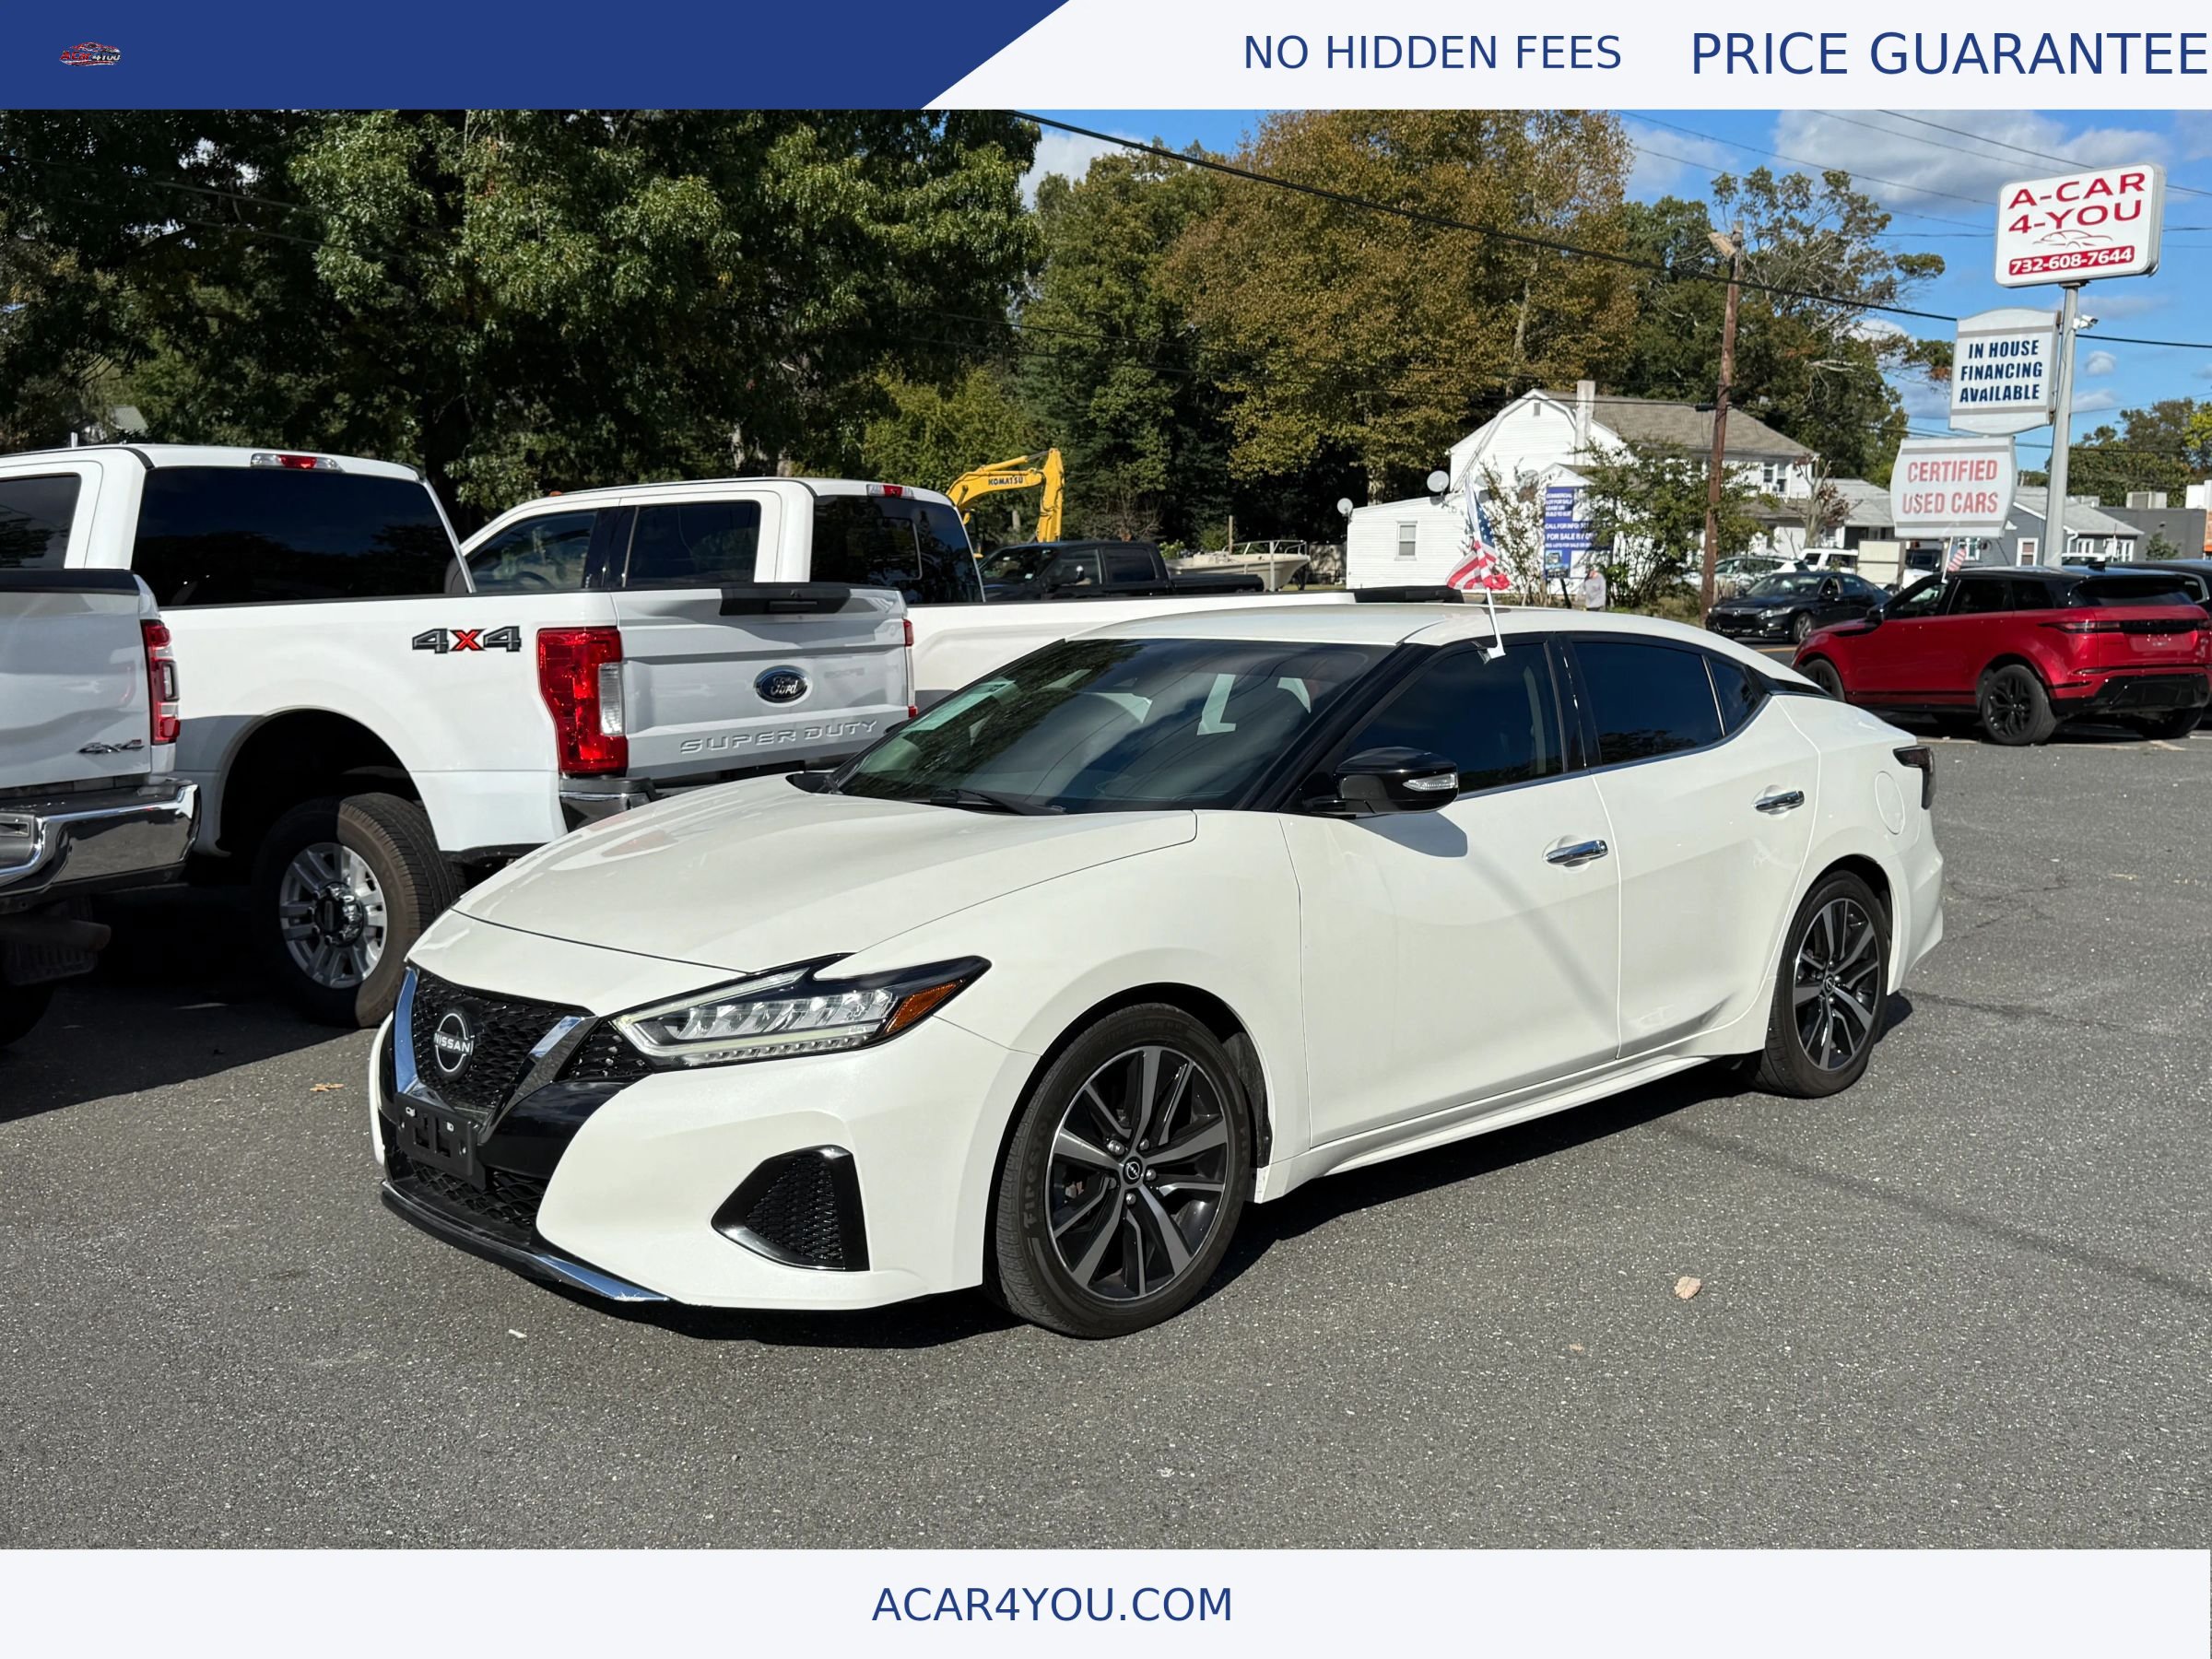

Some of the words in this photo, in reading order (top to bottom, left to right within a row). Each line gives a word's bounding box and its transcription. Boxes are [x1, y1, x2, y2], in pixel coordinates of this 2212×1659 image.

[2007, 172, 2146, 209] A-CAR
[2008, 199, 2141, 234] 4-YOU
[2010, 248, 2132, 275] 732-608-7644
[1968, 343, 1984, 359] IN
[1988, 339, 2040, 358] HOUSE
[1960, 361, 2042, 381] FINANCING
[1959, 383, 2040, 403] AVAILABLE
[988, 477, 1024, 486] KOMATSU
[1907, 459, 1998, 483] CERTIFIED
[1901, 492, 1946, 514] USED
[1950, 491, 1998, 514] CARS
[1547, 533, 1559, 541] FOR
[1559, 533, 1576, 541] SALE
[771, 676, 799, 696] Ford
[680, 729, 797, 755] SUPER
[804, 720, 877, 741] DUTY
[433, 1031, 472, 1053] NISSAN
